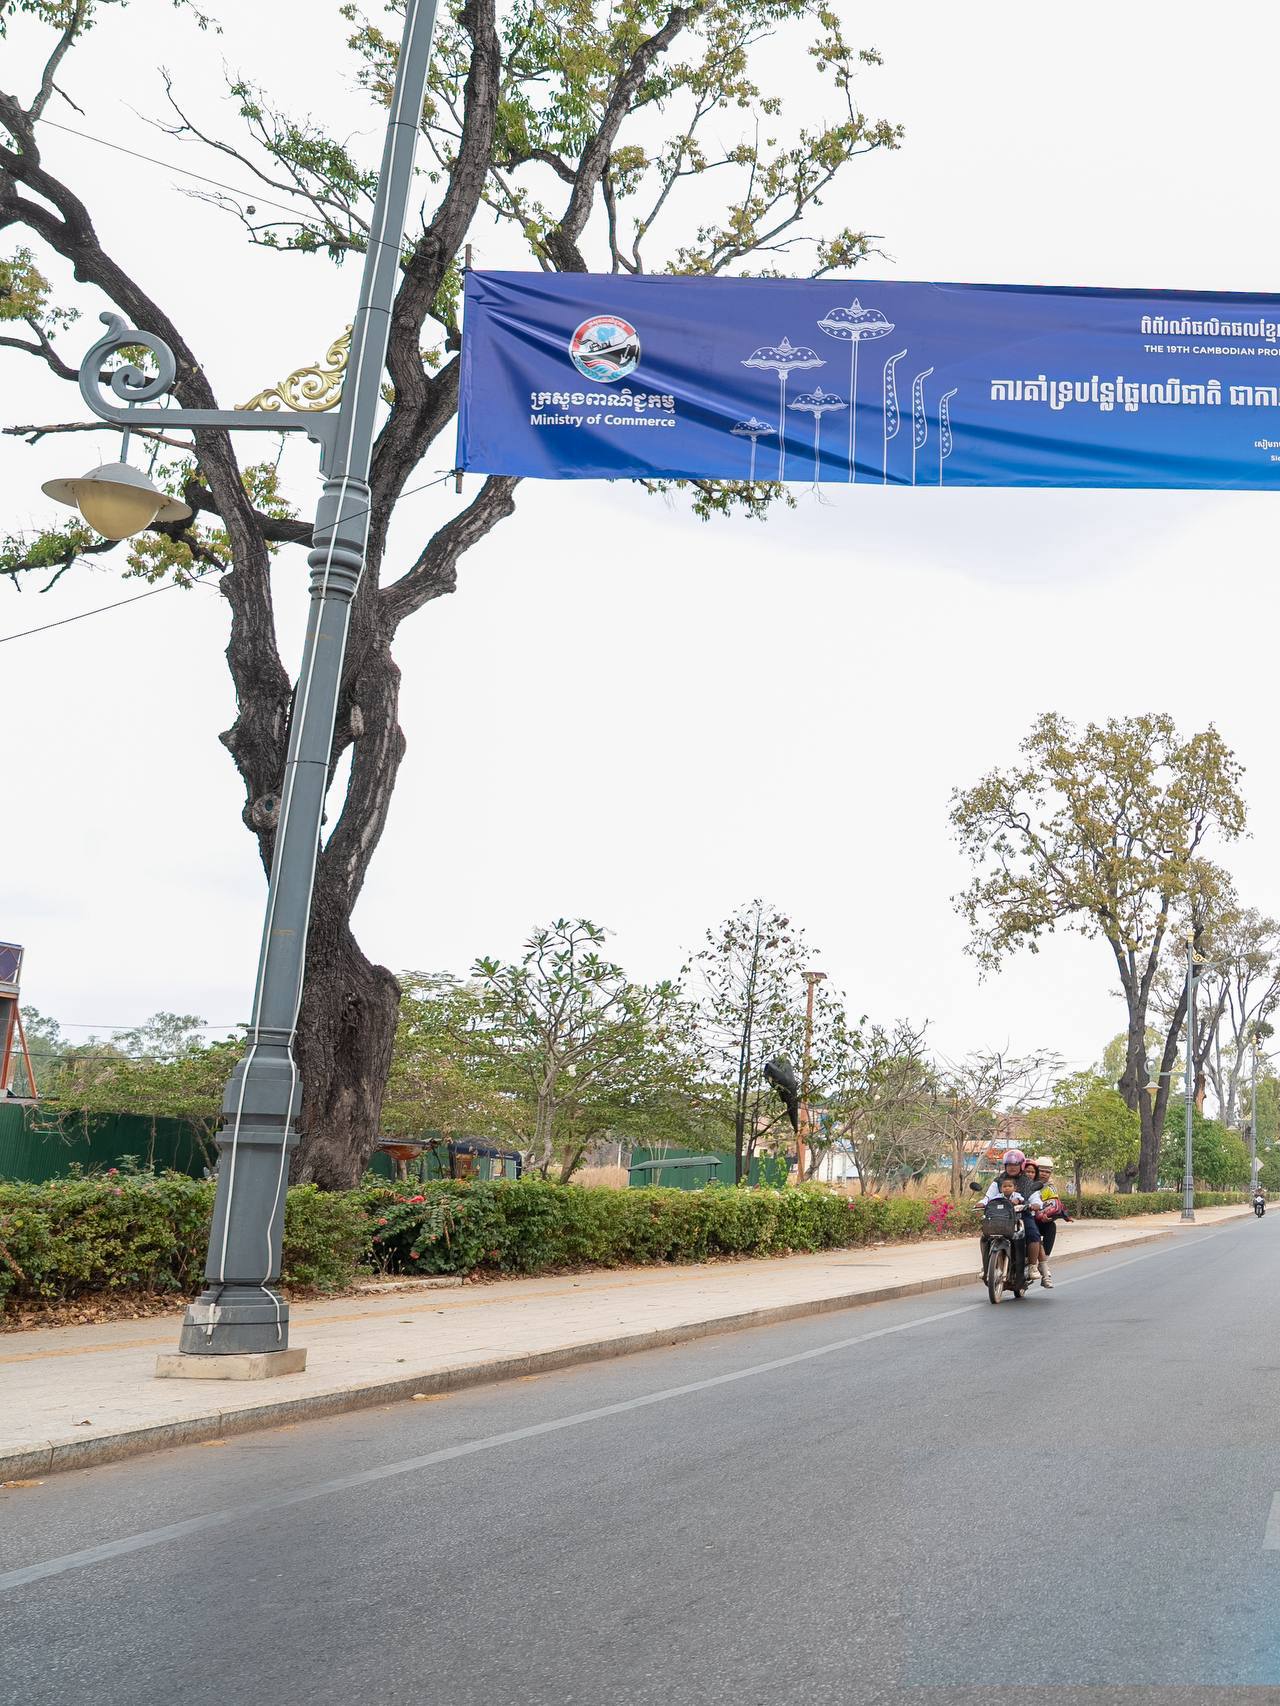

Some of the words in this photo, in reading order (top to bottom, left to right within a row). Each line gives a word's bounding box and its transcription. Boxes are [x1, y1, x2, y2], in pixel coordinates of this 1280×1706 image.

[1144, 345, 1164, 353] THE
[1166, 345, 1190, 354] 19TH
[1192, 346, 1255, 356] CAMBODIAN
[530, 388, 676, 414] ក្រសួងពាណិជ្ជកម្ម
[530, 414, 583, 427] Ministry
[586, 414, 602, 425] of
[604, 414, 676, 427] Commerce
